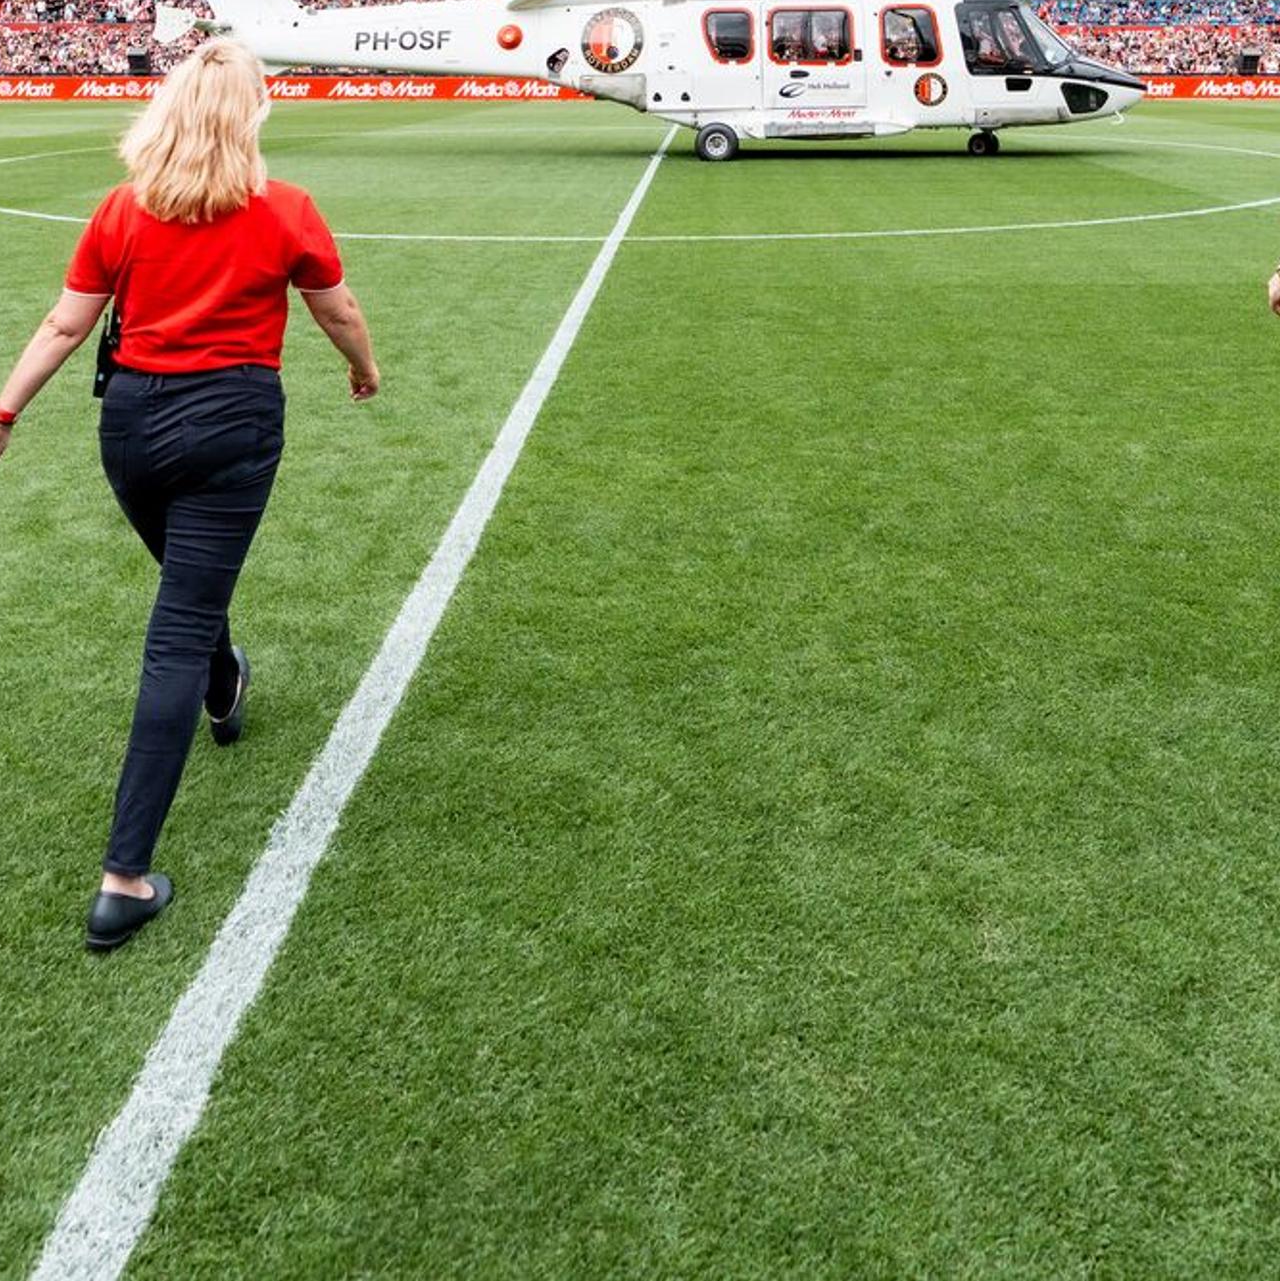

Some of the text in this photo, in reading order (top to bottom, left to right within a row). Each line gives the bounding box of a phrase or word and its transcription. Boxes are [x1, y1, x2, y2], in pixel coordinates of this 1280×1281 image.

[354, 29, 453, 51] PH-OSF
[8, 80, 55, 96] Markt
[74, 80, 120, 97] Media
[268, 81, 310, 97] Markt
[328, 81, 436, 97] Media Markt
[454, 81, 503, 97] Media
[1147, 81, 1176, 96] arkt
[1194, 80, 1242, 96] Media
